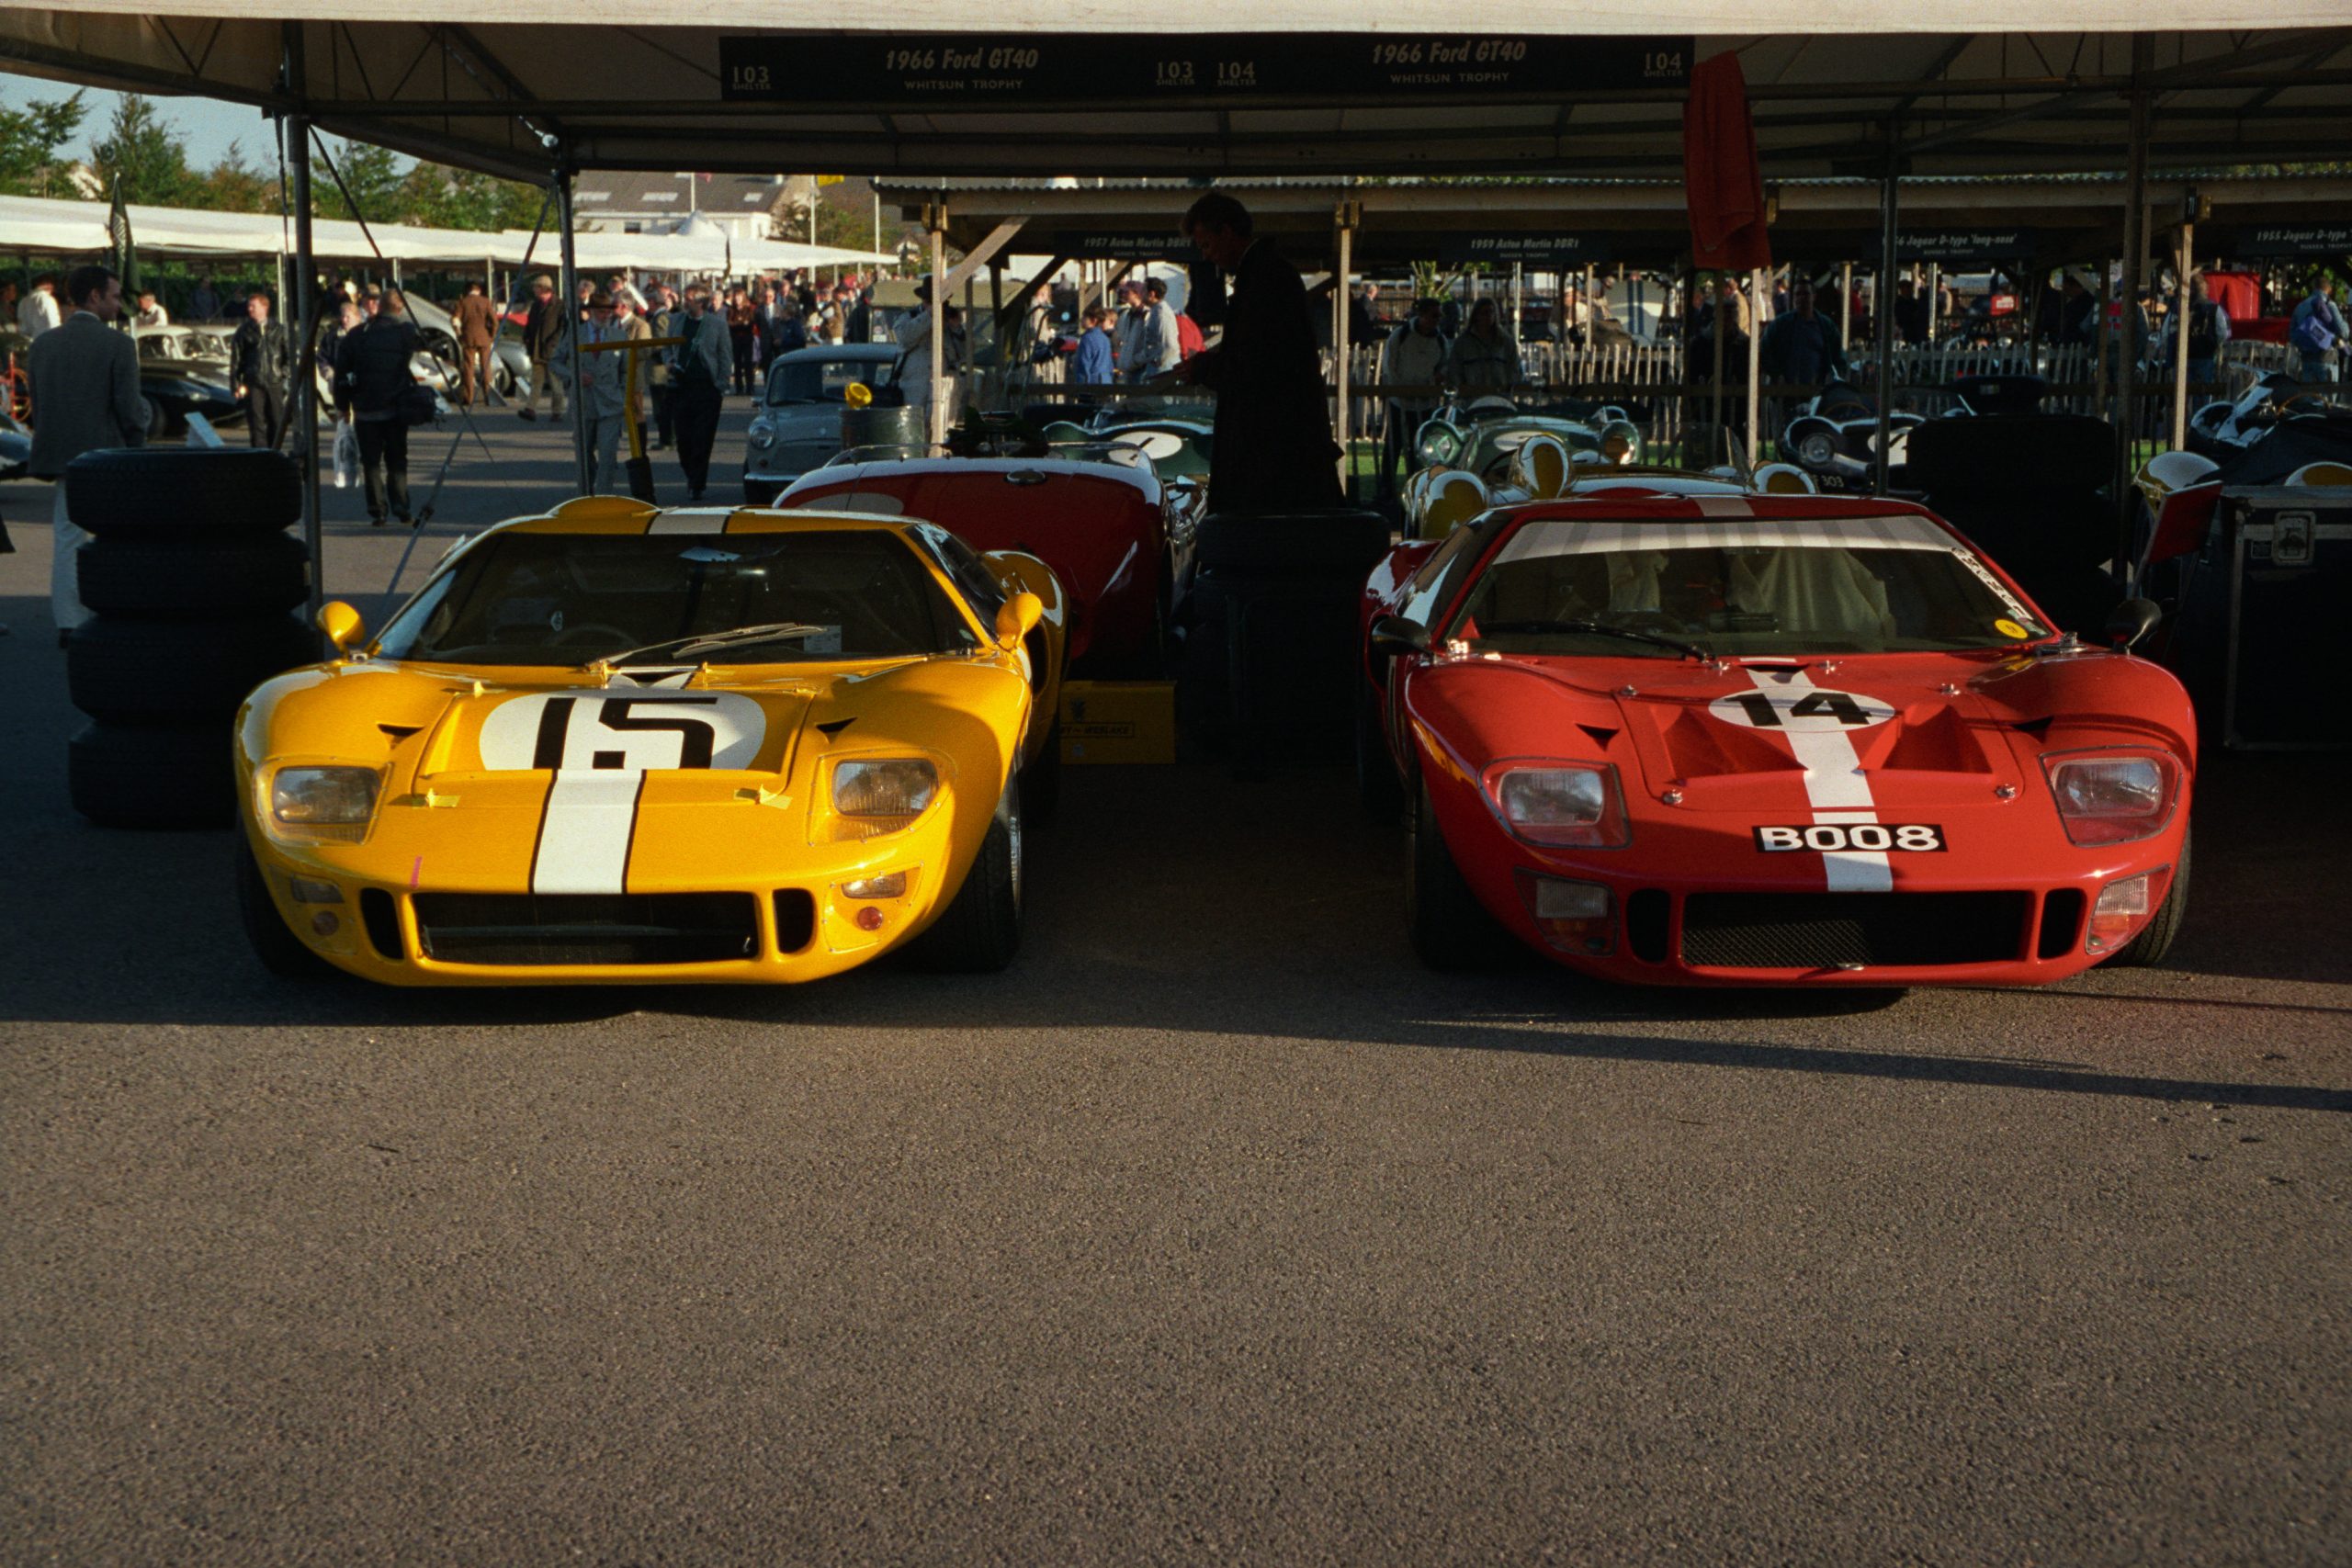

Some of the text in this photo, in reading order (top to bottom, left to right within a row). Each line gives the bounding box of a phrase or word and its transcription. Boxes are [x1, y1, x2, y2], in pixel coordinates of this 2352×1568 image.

[886, 46, 1039, 71] 1966 Ford GT40
[1372, 39, 1526, 64] 1966 Ford GT40
[1645, 51, 1682, 70] 104
[733, 65, 770, 84] 103
[1158, 61, 1193, 79] 103
[1218, 61, 1256, 79] 104
[1390, 73, 1510, 85] WHITSUN TROPHY
[1643, 70, 1683, 78] SHELTER
[732, 83, 773, 91] SHELTER
[904, 79, 1023, 90] WHITSUN TROPHY
[1156, 78, 1195, 86] SHELTER
[1217, 79, 1257, 87] SHELTER
[1724, 692, 1871, 727] 14
[533, 697, 718, 770] 15
